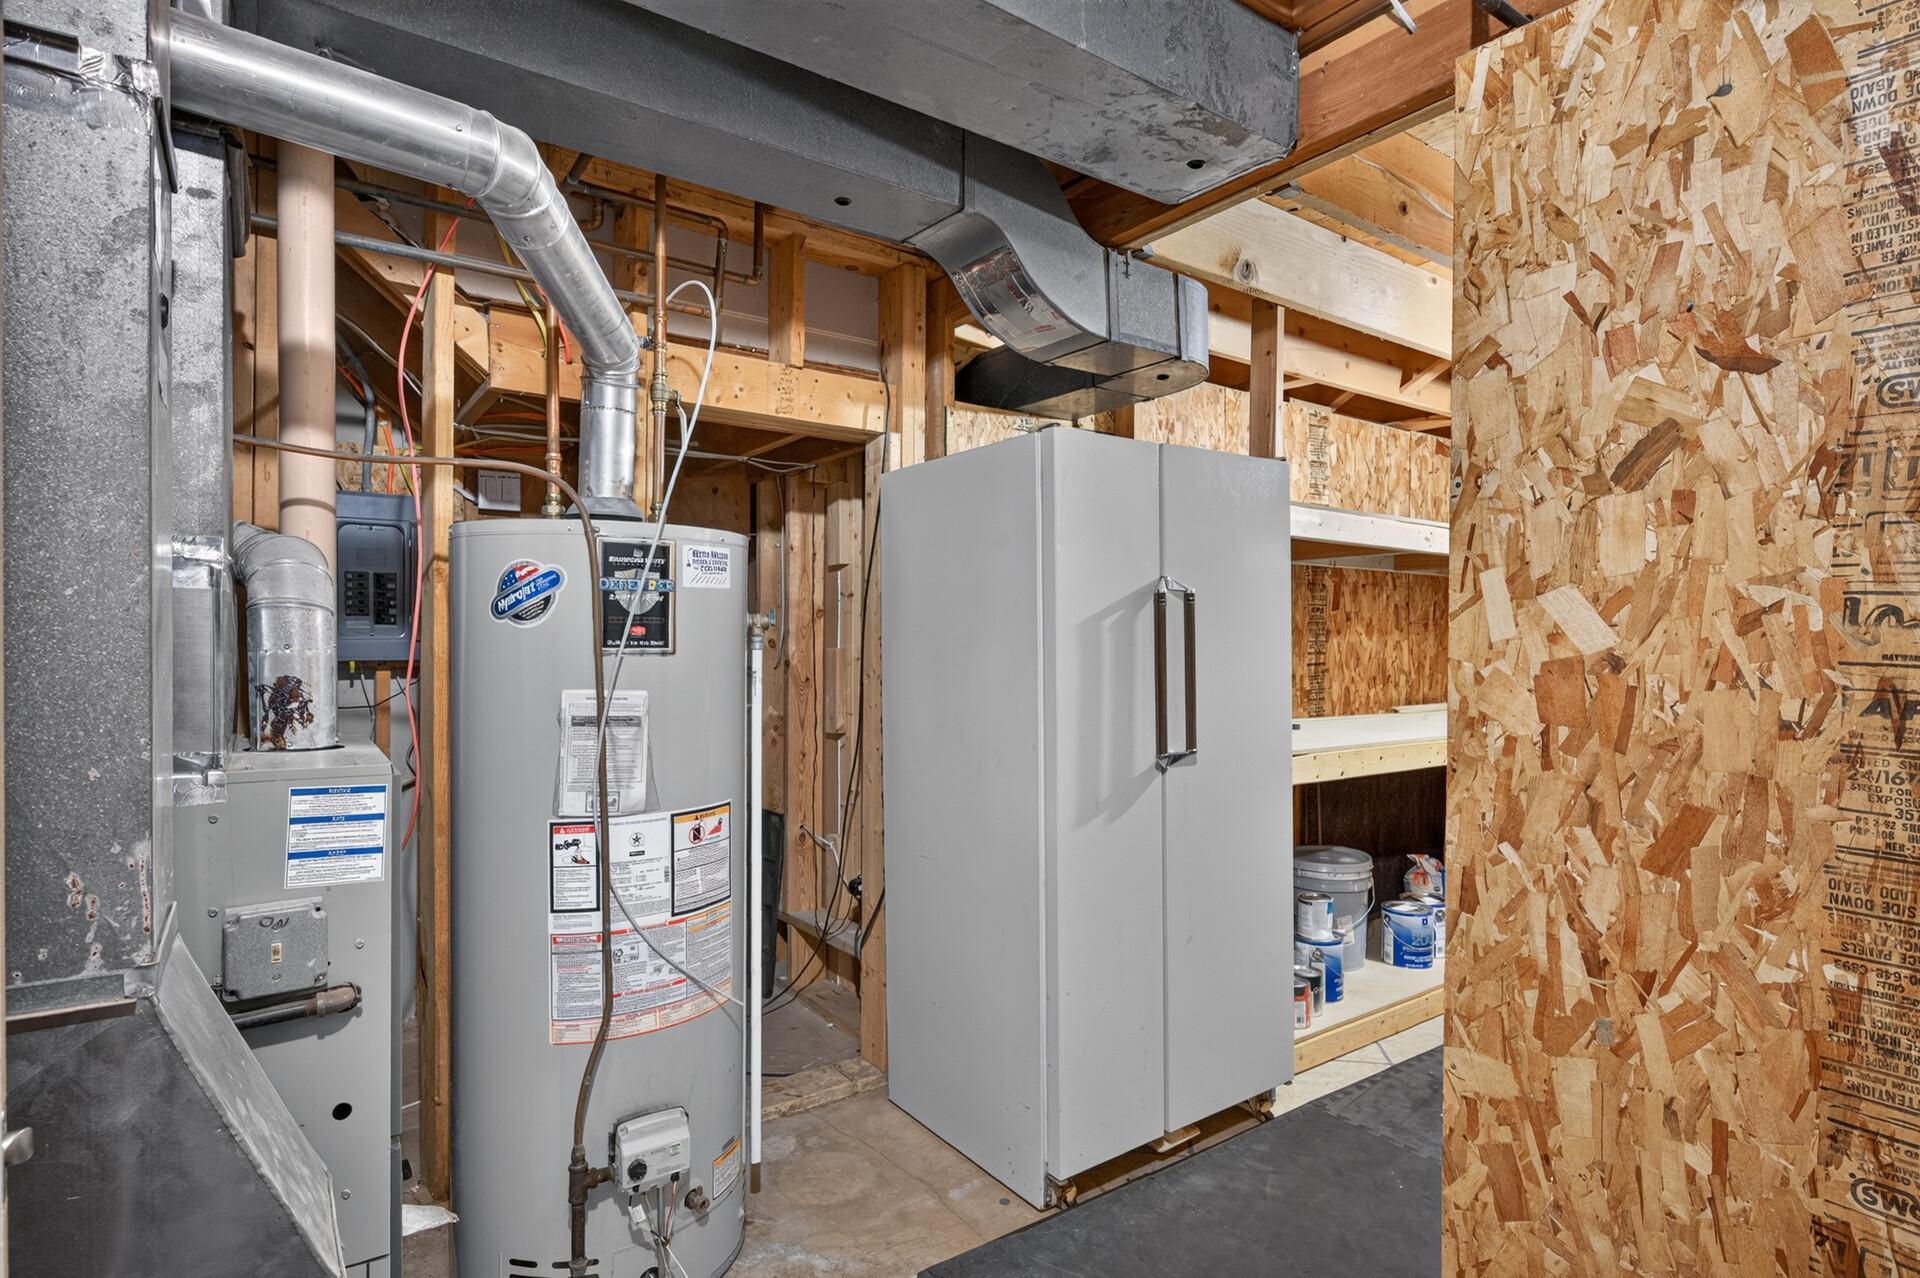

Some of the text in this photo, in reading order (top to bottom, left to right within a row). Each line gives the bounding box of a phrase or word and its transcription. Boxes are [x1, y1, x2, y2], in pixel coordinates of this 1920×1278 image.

[1850, 76, 1896, 99] ABAJO
[1853, 89, 1898, 114] DOWN
[1851, 232, 1862, 244] IN
[1851, 238, 1893, 256] PANELS
[600, 578, 674, 592] DEFEDER
[1890, 788, 1912, 797] FOR
[1880, 887, 1917, 904] LADO
[1829, 892, 1916, 919] SIDE DOWN
[1841, 941, 1892, 961] PANELS
